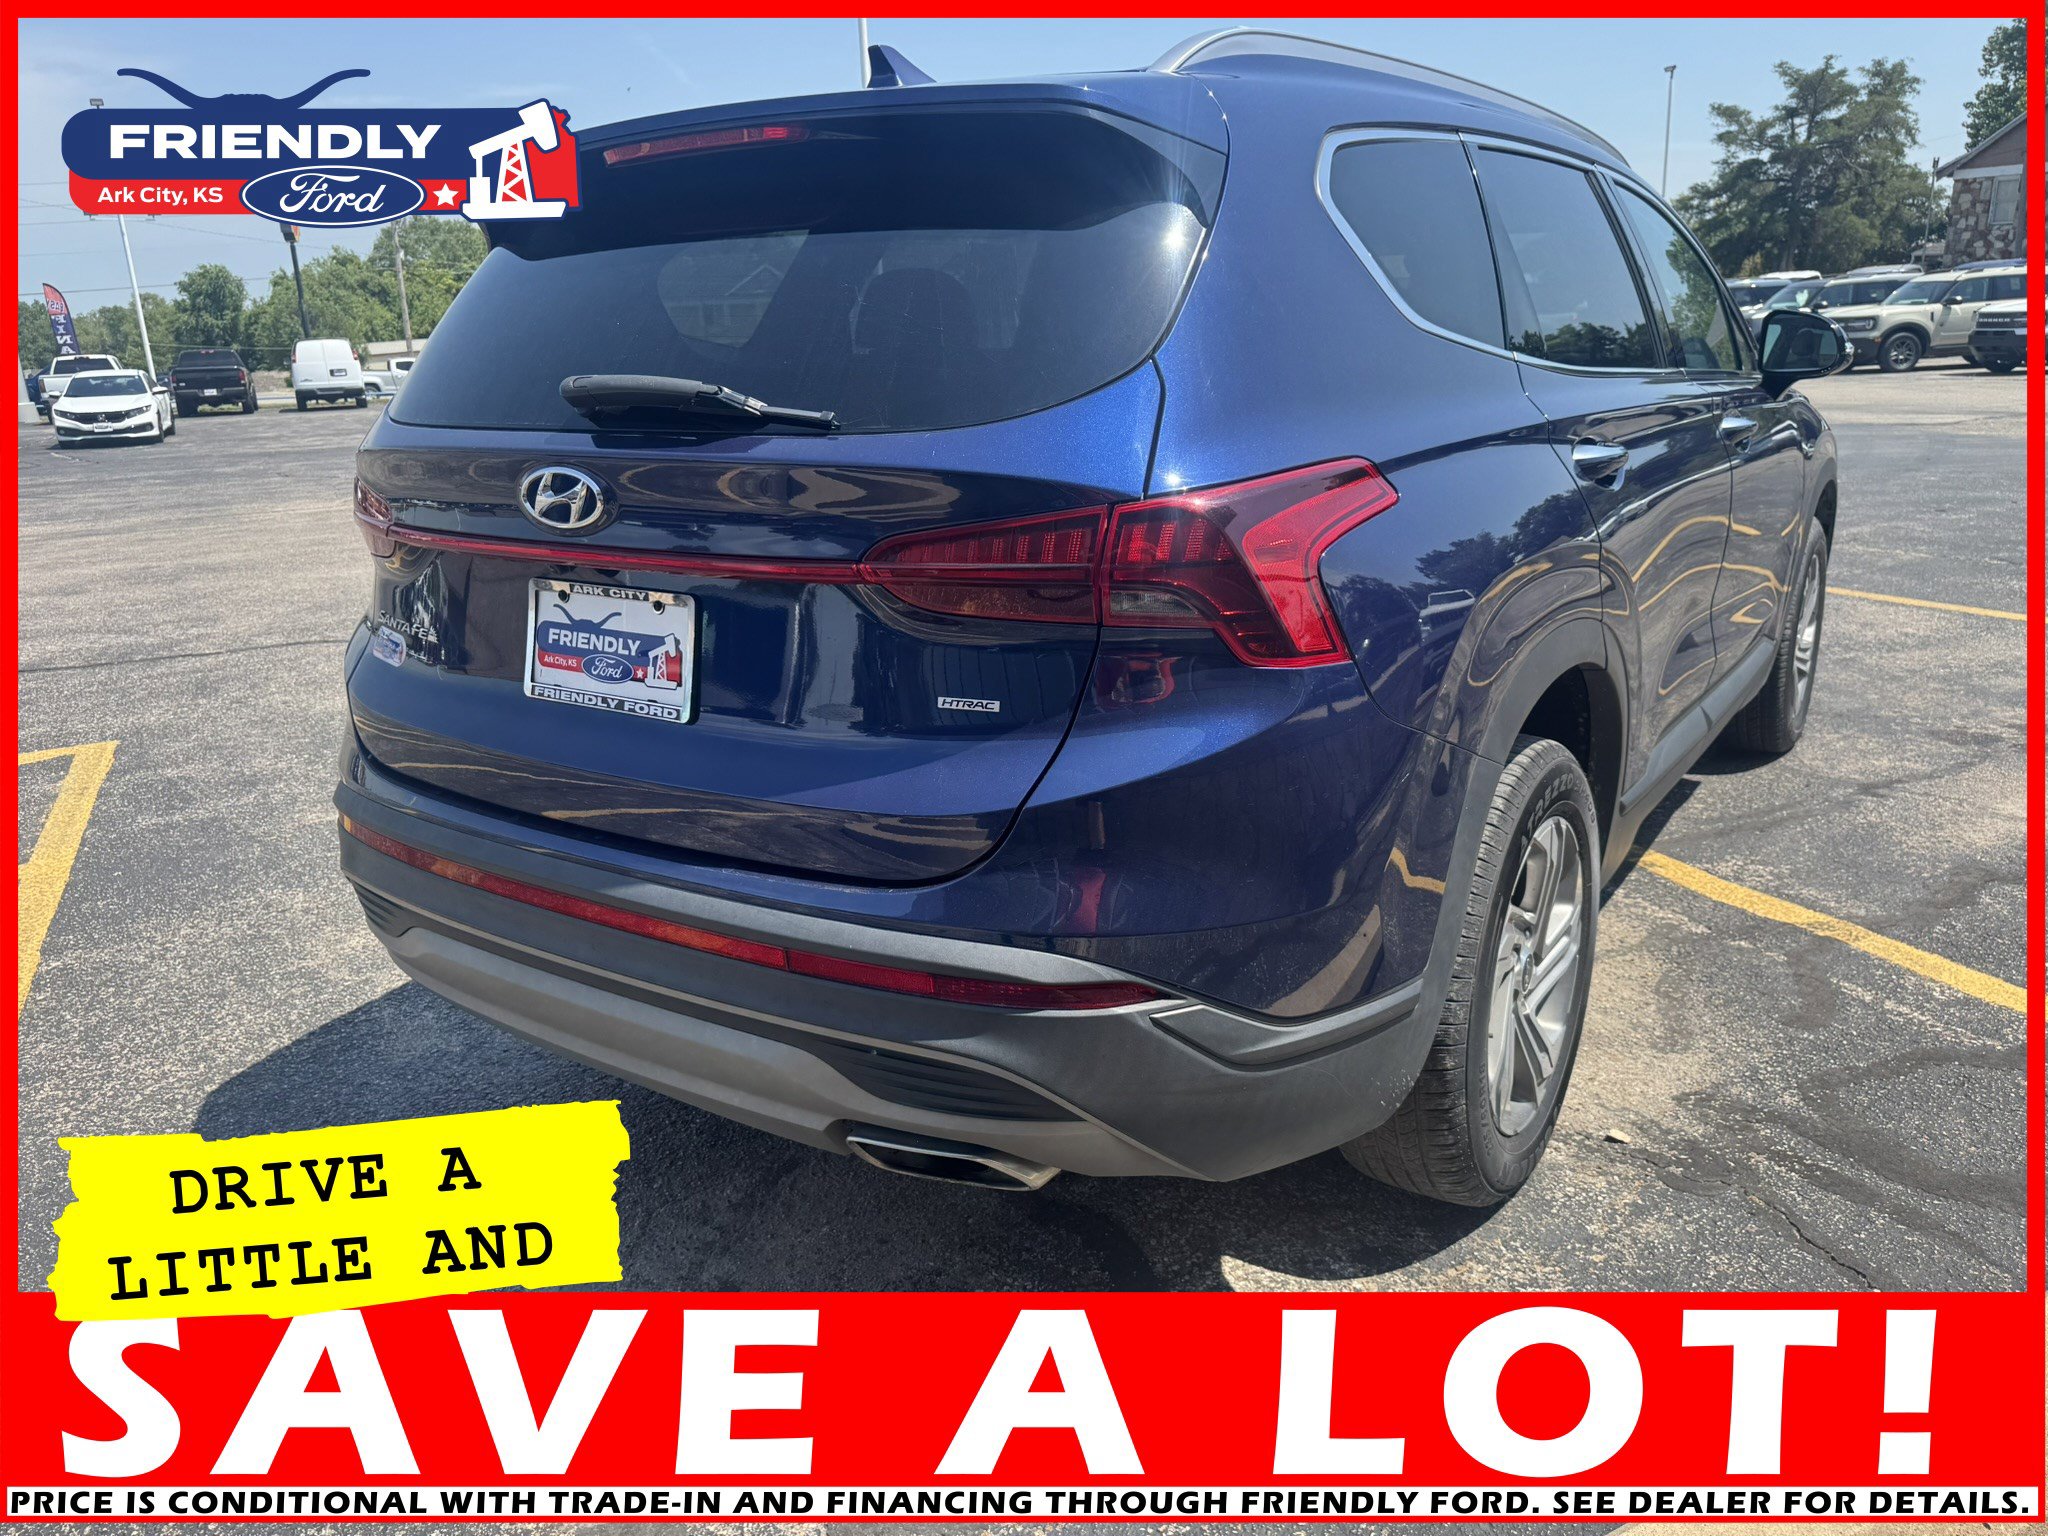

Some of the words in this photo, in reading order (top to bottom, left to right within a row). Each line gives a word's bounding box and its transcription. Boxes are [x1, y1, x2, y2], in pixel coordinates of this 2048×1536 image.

[573, 584, 604, 596] ARK
[609, 590, 646, 600] CITY
[548, 628, 641, 657] FRIENDLY
[544, 655, 554, 663] Ark
[555, 657, 567, 667] City,
[568, 658, 577, 667] KS
[591, 656, 623, 679] Ford
[534, 687, 619, 709] FRIENDLY
[624, 701, 678, 719] FORD
[941, 699, 995, 710] HTRAC
